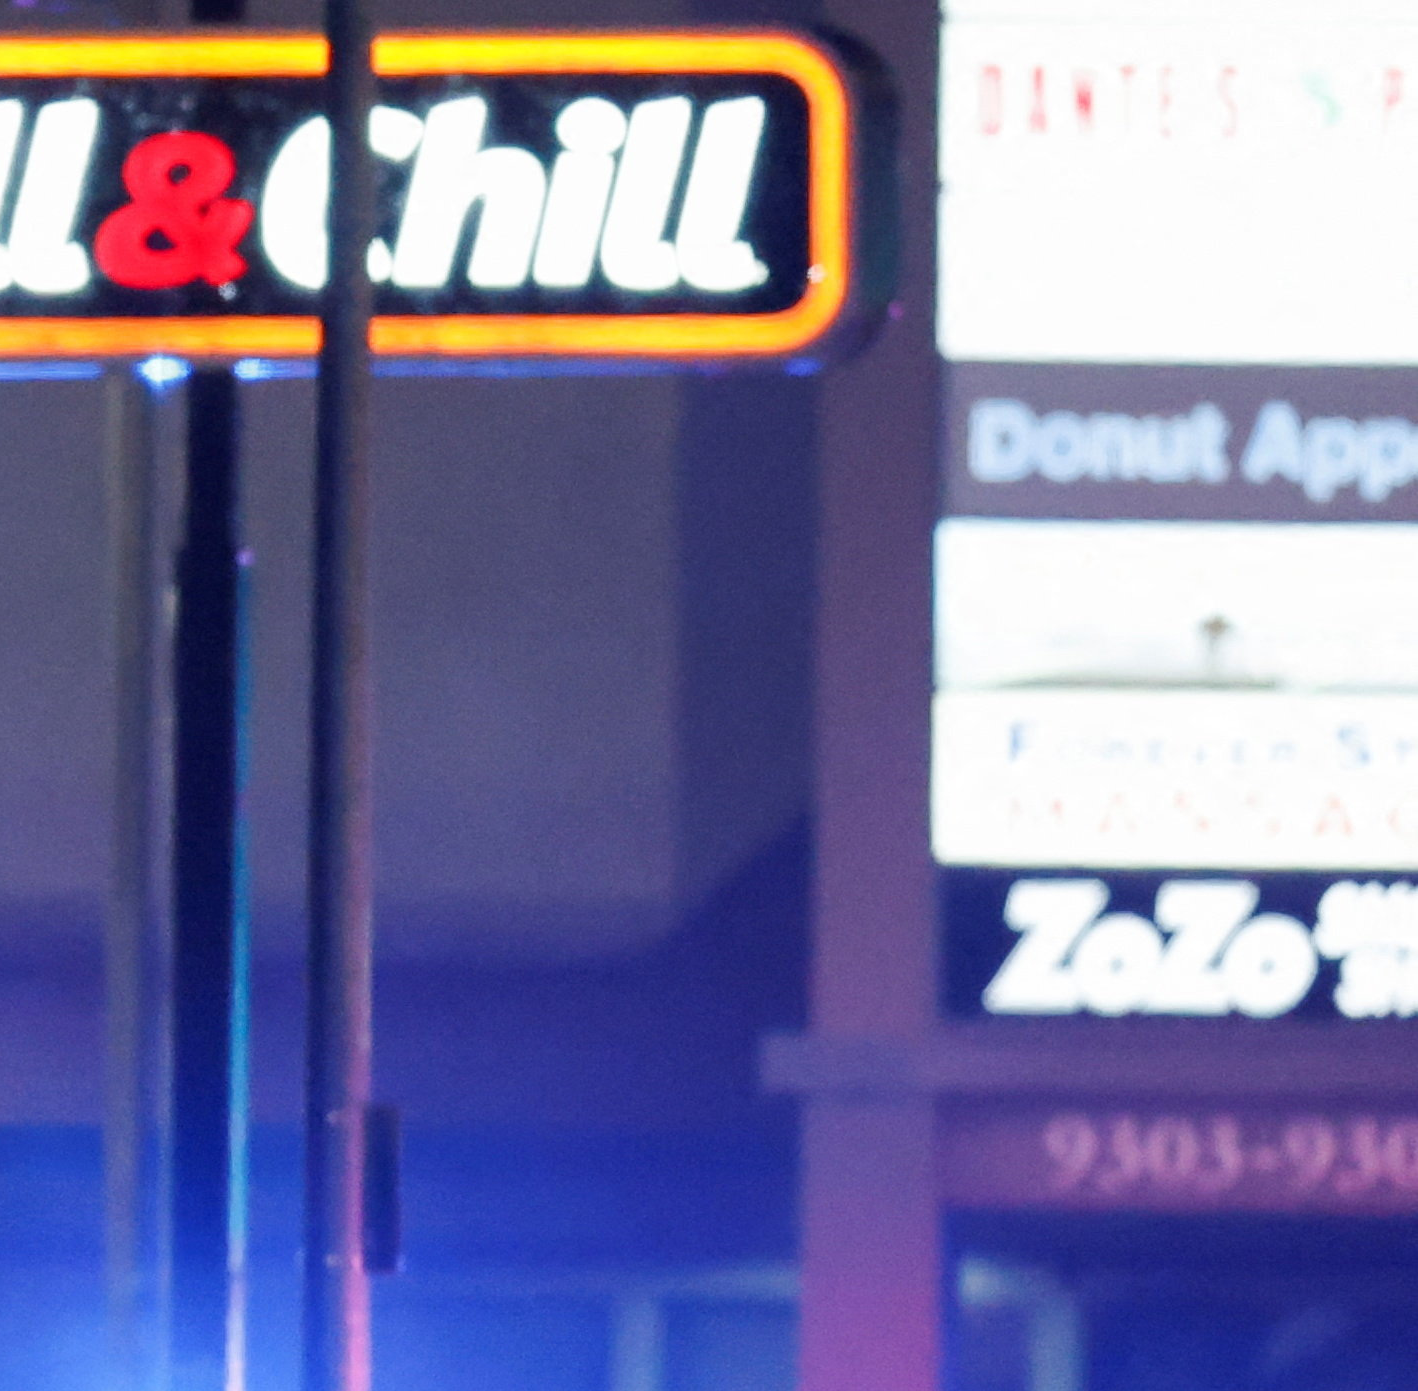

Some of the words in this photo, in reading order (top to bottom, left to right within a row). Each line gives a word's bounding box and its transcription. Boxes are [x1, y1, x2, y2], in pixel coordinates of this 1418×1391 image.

[93, 130, 257, 291] &
[260, 95, 768, 292] Chill
[968, 399, 1230, 483] Donut
